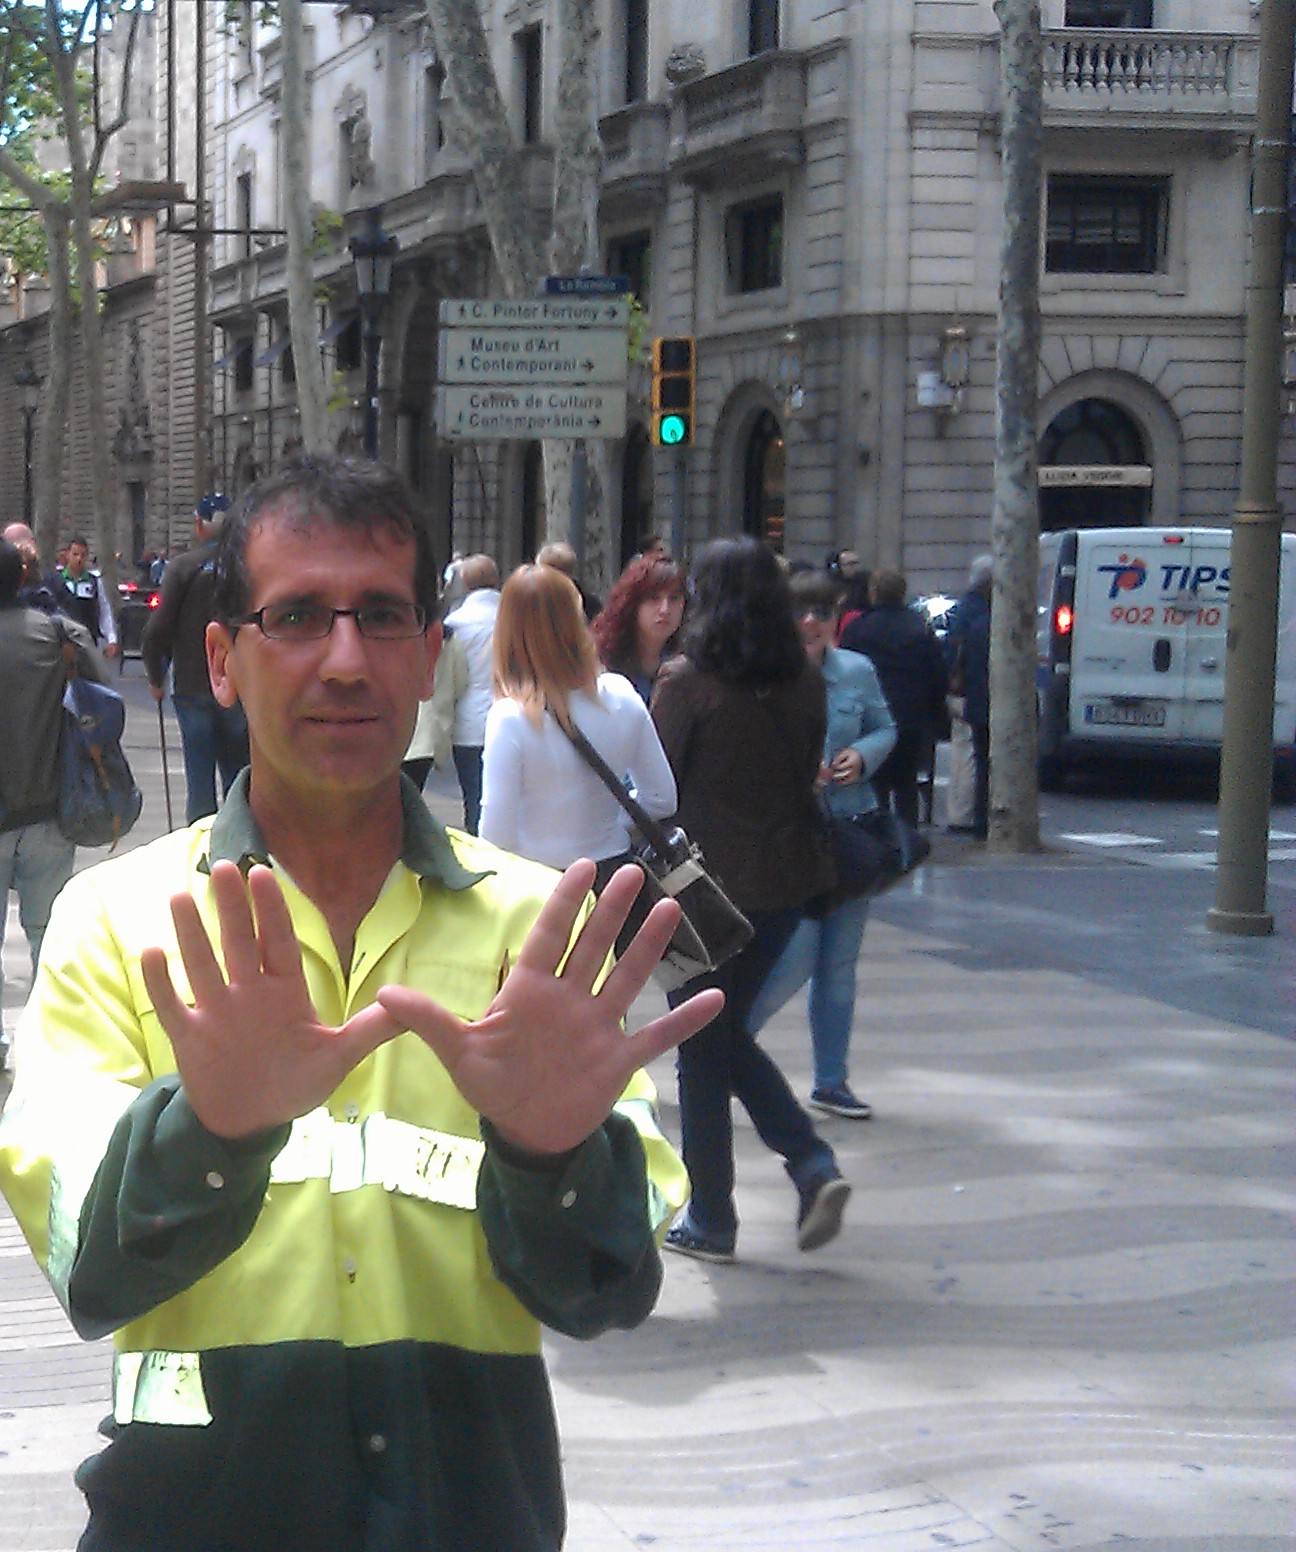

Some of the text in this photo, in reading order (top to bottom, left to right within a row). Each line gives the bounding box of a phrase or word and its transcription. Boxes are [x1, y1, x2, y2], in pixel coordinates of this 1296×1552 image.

[472, 303, 487, 318] C.
[470, 337, 560, 352] Museu d'Art
[470, 355, 577, 374] Contemporani
[525, 394, 543, 409] de
[549, 394, 604, 409] Cultura
[1110, 606, 1155, 625] 902
[1196, 606, 1221, 626] 10
